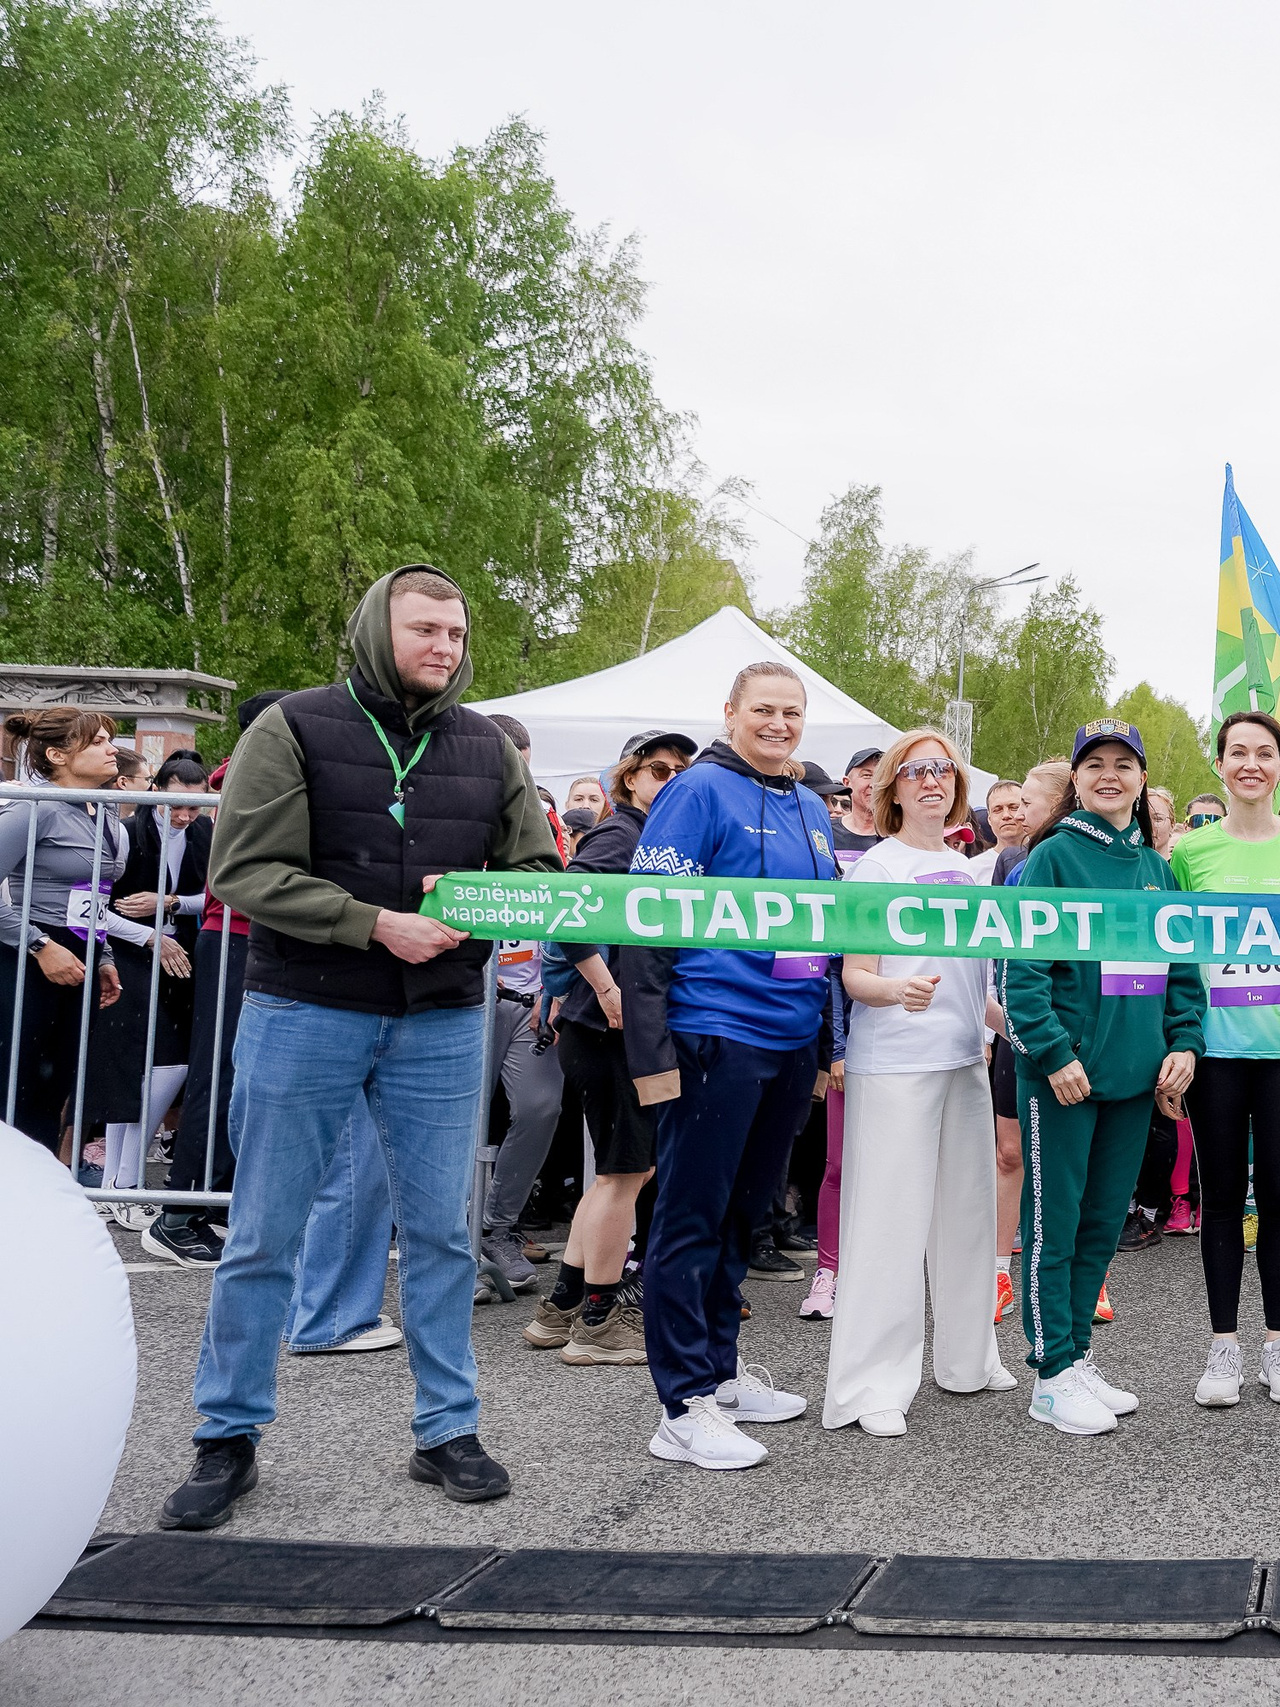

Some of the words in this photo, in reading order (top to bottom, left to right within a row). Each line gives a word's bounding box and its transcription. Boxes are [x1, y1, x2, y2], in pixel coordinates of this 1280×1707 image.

[453, 882, 553, 904] зелёный
[442, 903, 545, 927] марафон
[626, 886, 836, 941] СТАРТ
[887, 896, 1103, 950] СТАРТ
